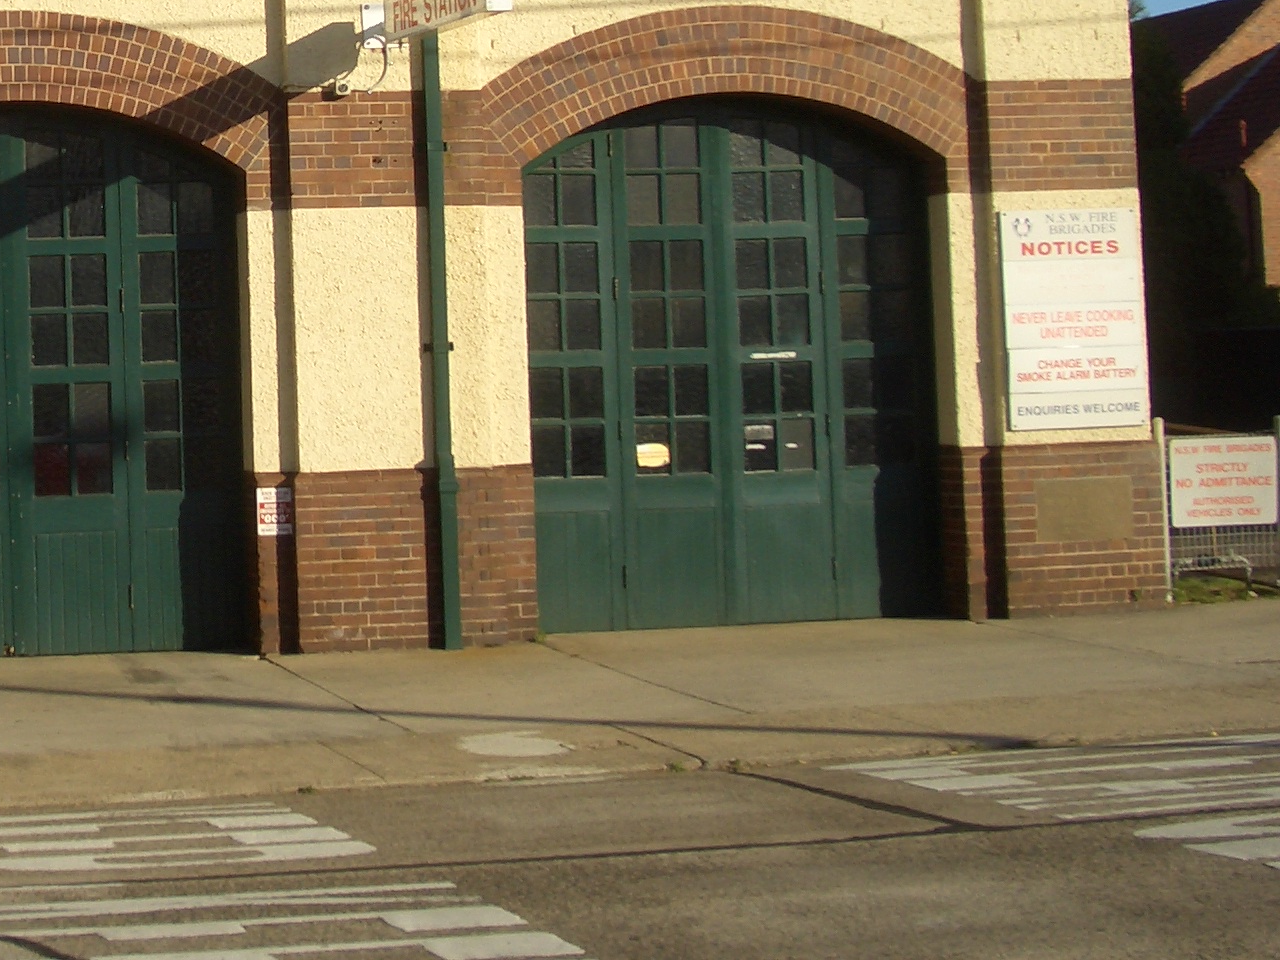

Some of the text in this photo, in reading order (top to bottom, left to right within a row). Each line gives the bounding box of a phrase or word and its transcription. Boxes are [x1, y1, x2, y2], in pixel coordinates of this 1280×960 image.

[1089, 212, 1118, 222] FIRE
[1049, 224, 1116, 235] BRIGADES
[1021, 240, 1119, 256] NOTICES
[1012, 310, 1134, 324] NEVER LEAVE COOKING
[1040, 325, 1108, 339] UNATTENDED
[1037, 357, 1116, 369] CHANGE YOUR
[1016, 368, 1136, 382] SMOKE ALARM BATTERY
[1017, 402, 1141, 416] ENQUIRIES WELCOME
[1195, 463, 1248, 473] STRICTLY
[1176, 476, 1272, 488] NO ADMITTANCE
[1238, 507, 1261, 516] ONLY
